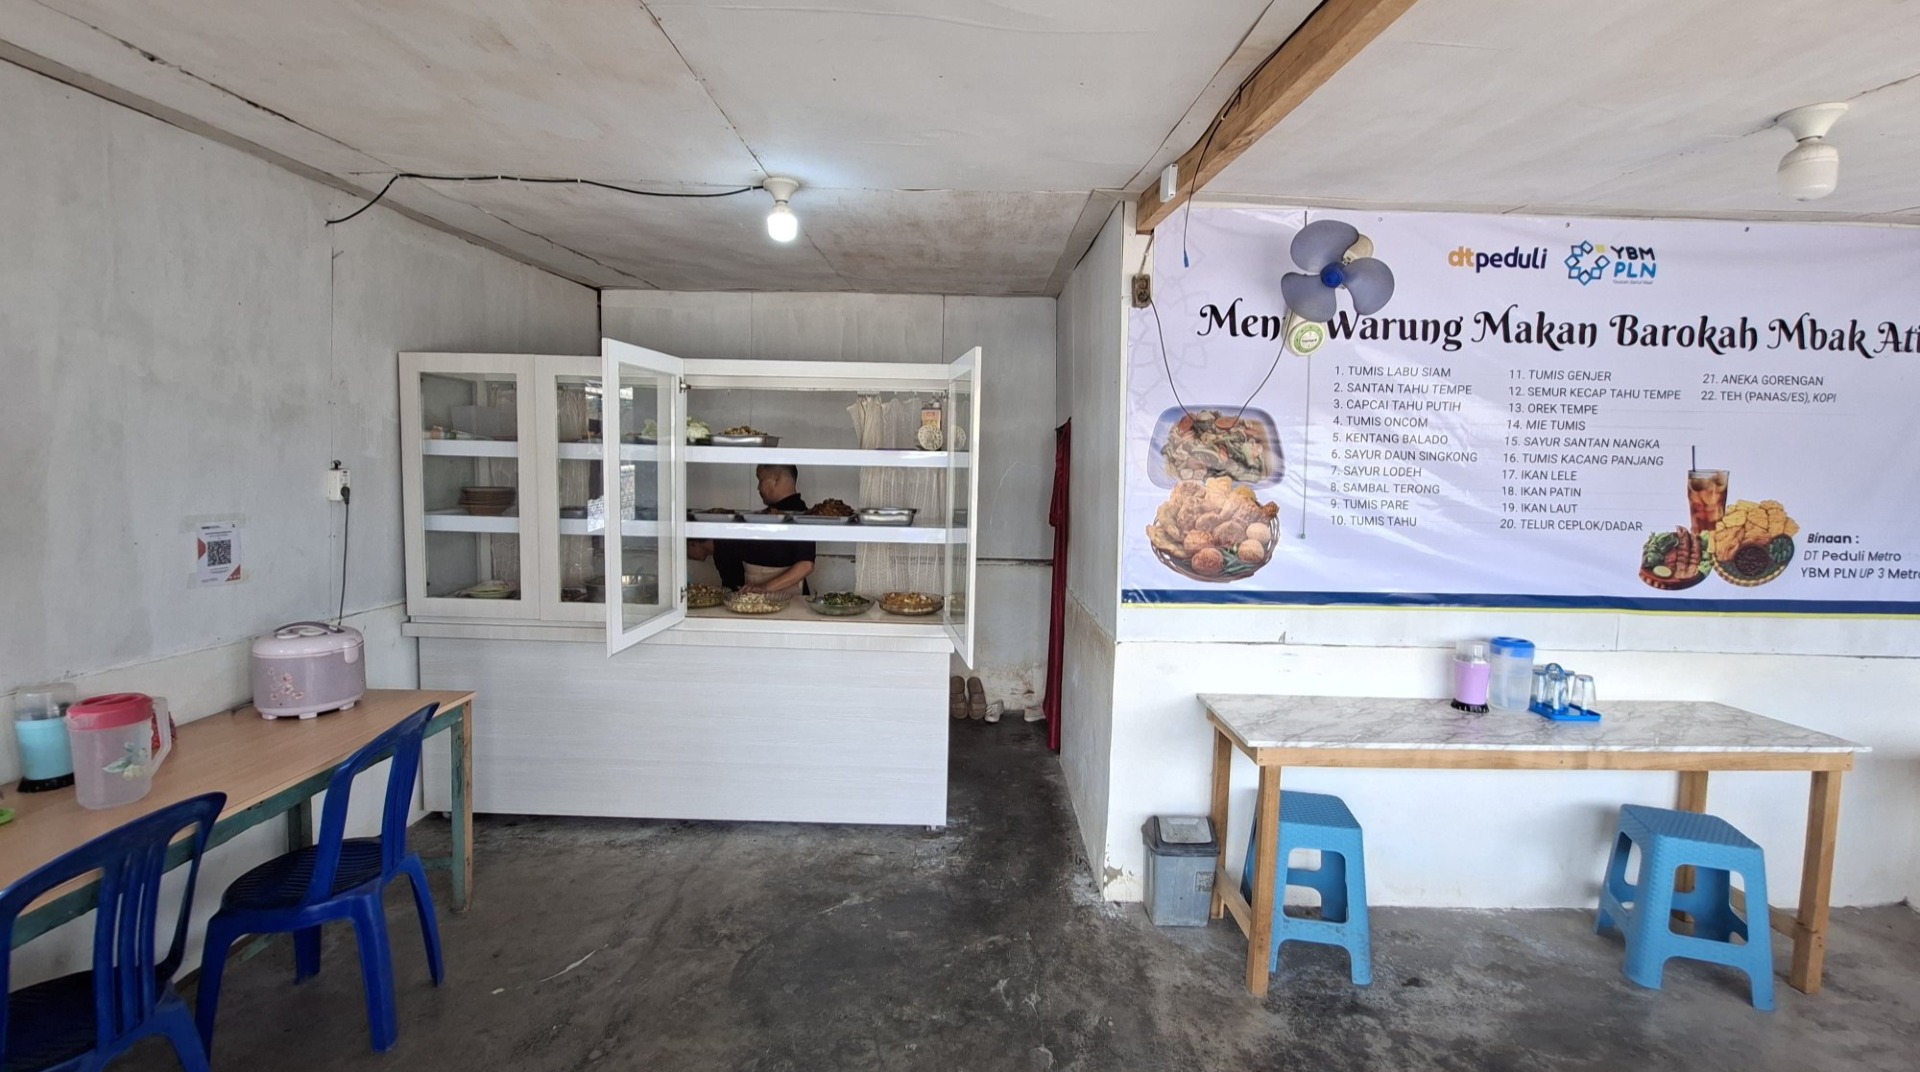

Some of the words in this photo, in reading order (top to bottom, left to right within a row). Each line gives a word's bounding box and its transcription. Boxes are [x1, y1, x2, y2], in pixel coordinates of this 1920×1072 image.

[1610, 246, 1655, 260] YBM
[1614, 262, 1656, 278] PLN
[1196, 297, 1287, 340] Men
[1327, 310, 1463, 352] Warung
[1470, 304, 1597, 351] Makan
[1609, 313, 1758, 355] Barokah
[1767, 312, 1875, 359] Mbak
[1335, 366, 1344, 376] 1.
[1348, 366, 1384, 376] TUMIS
[1387, 367, 1419, 377] LABU
[1421, 367, 1451, 377] SIAM
[1509, 370, 1525, 379] 11.
[1528, 370, 1565, 380] TUMIS
[1567, 371, 1612, 381] GENJER
[1702, 373, 1718, 384] 21.
[1721, 374, 1758, 385] ANEKA
[1761, 375, 1824, 386] GORENGAN
[1334, 383, 1343, 393] 2.
[1347, 383, 1394, 393] SANTAN
[1397, 384, 1429, 394] TAHU
[1432, 384, 1472, 394] TEMPE
[1508, 386, 1524, 396] 12.
[1527, 387, 1567, 397] SEMUR
[1570, 388, 1607, 398] KECAP
[1610, 389, 1640, 399] TAHU
[1643, 389, 1681, 399] TEMPE
[1701, 390, 1716, 401] 22.
[1720, 391, 1742, 401] TEH
[1745, 391, 1810, 404] (PANAS/ES),
[1812, 392, 1837, 403] KOPI
[1333, 399, 1343, 409] 3.
[1346, 400, 1389, 410] CAPCAI
[1392, 401, 1423, 411] TAHU
[1426, 401, 1461, 411] PUTIH
[1508, 403, 1524, 413] 13.
[1527, 403, 1557, 413] OREK
[1560, 404, 1598, 414] TEMPE
[1333, 416, 1342, 426] 4.
[1346, 416, 1381, 426] TUMIS
[1384, 417, 1428, 427] ONCOM
[1507, 420, 1523, 430] 14.
[1526, 420, 1547, 430] MIE
[1550, 420, 1586, 431] TUMIS
[1332, 433, 1341, 442] 5.
[1345, 433, 1399, 443] KENTANG
[1402, 434, 1448, 444] BALADO
[1504, 436, 1520, 446] 15.
[1523, 437, 1561, 447] SAYUR
[1563, 438, 1610, 448] SANTAN
[1612, 439, 1660, 449] NANGKA
[1331, 449, 1340, 459] 6.
[1344, 449, 1381, 460] SAYUR
[1385, 450, 1416, 460] DAUN
[1419, 451, 1478, 462] SINGKONG
[1503, 453, 1519, 463] 16.
[1522, 453, 1558, 464] TUMIS
[1560, 454, 1608, 465] KACANG
[1611, 455, 1664, 466] PANJANG
[1331, 465, 1340, 476] 7.
[1343, 466, 1380, 476] SAYUR
[1383, 467, 1422, 477] LODEH
[1502, 469, 1518, 480] 17.
[1521, 470, 1548, 480] IKAN
[1551, 470, 1577, 481] LELE
[1330, 483, 1339, 492] 8.
[1343, 483, 1390, 493] SAMBAL
[1393, 484, 1440, 494] TERONG
[1501, 486, 1517, 496] 18.
[1520, 487, 1547, 496] IKAN
[1549, 487, 1581, 497] PATIN
[1330, 499, 1339, 509] 9.
[1342, 499, 1378, 510] TUMIS
[1380, 500, 1409, 510] PARE
[1502, 503, 1518, 513] 19.
[1521, 503, 1547, 513] IKAN
[1549, 503, 1578, 514] LAUT
[1330, 515, 1346, 525] 10.
[1350, 515, 1385, 526] TUMIS
[1387, 516, 1417, 526] TAHU
[1500, 519, 1516, 529] 20.
[1520, 519, 1555, 530] TELUR
[1558, 520, 1643, 531] CEPLOK/DADAR
[1807, 532, 1852, 543] Binaan
[1803, 550, 1819, 560] DT
[1822, 550, 1865, 561] Peduli
[1867, 551, 1901, 562] Metro
[1801, 567, 1830, 578] YBM
[1834, 568, 1857, 578] PLN
[1860, 568, 1874, 578] UP
[1878, 567, 1884, 578] 3
